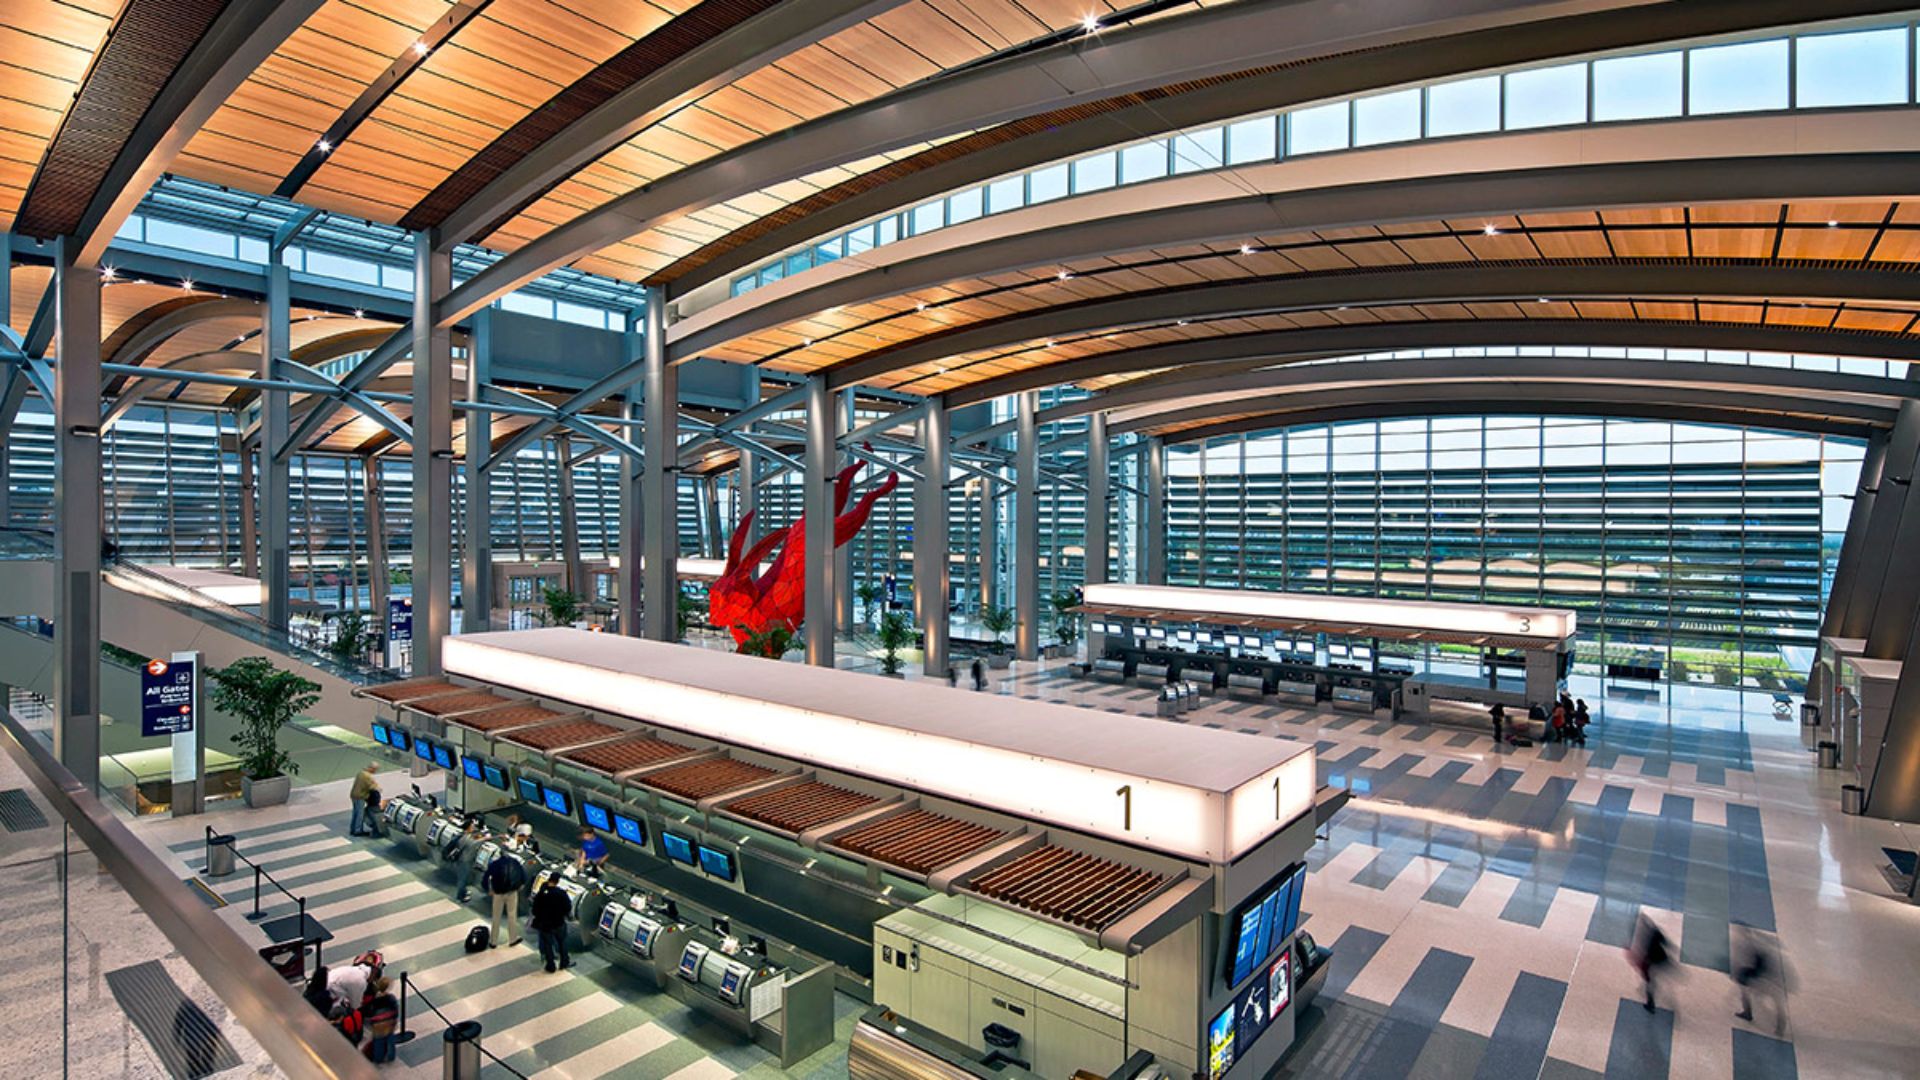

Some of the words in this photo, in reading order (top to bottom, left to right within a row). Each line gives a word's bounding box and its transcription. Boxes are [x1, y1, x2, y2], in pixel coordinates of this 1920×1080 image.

[1519, 615, 1531, 633] 3
[145, 686, 161, 695] All
[162, 685, 190, 694] Gates
[1116, 784, 1131, 831] 1
[1273, 776, 1280, 821] 1
